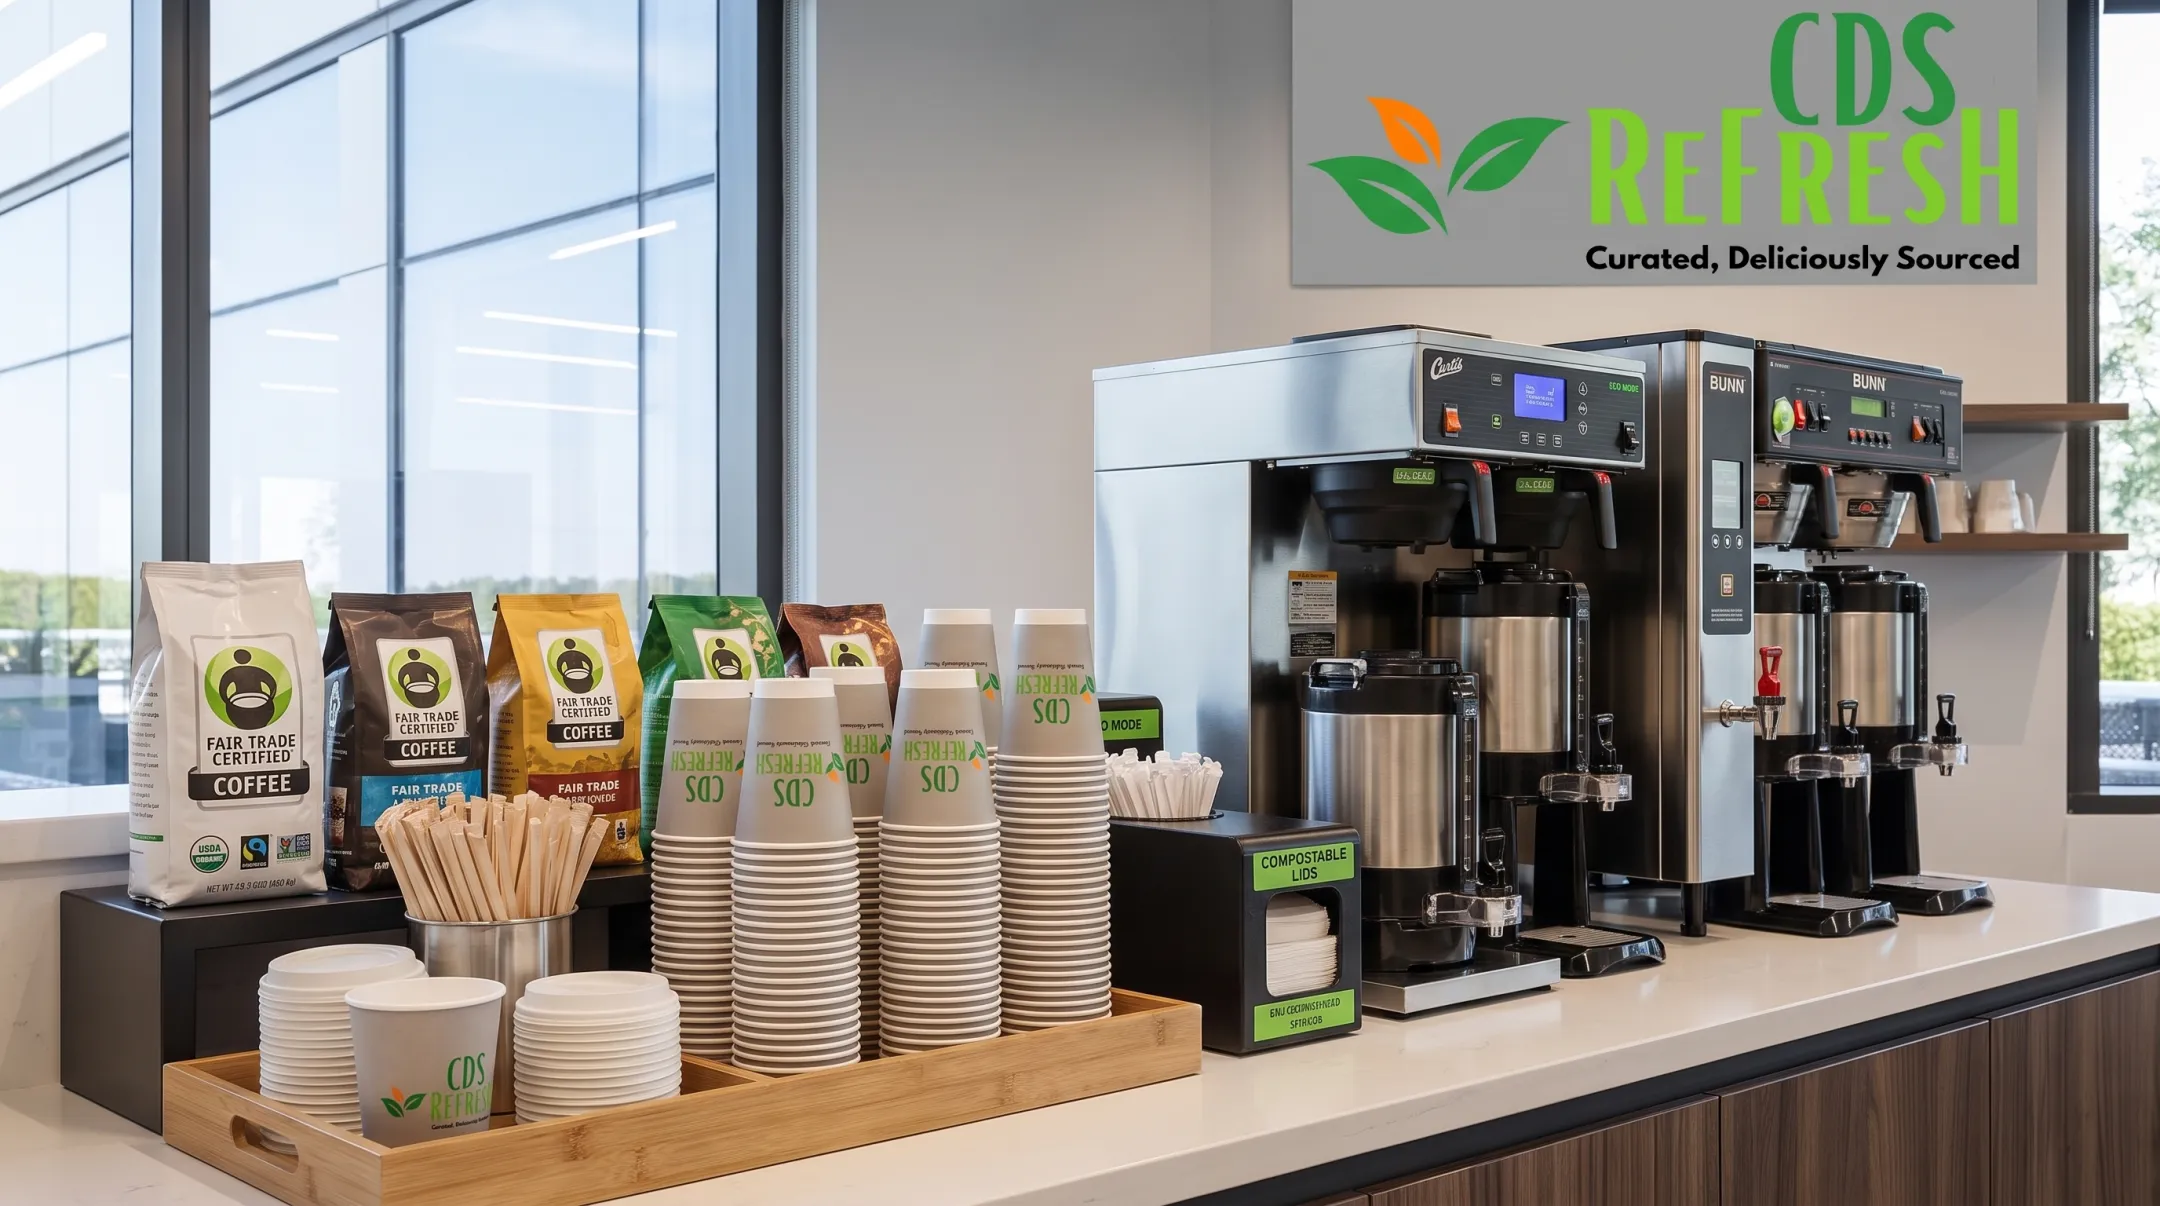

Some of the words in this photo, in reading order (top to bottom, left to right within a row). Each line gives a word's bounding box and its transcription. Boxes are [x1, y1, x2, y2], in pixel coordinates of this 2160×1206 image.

[1770, 12, 1956, 127] CDS
[1586, 245, 1719, 275] Curated,
[1729, 245, 1889, 277] Deliciously
[1897, 245, 2020, 271] Sourced
[1430, 356, 1463, 380] Curtis
[1710, 375, 1745, 393] BUNN
[1853, 373, 1886, 391] BUNN
[1016, 674, 1078, 696] REFRESH
[557, 697, 578, 707] FAIR
[580, 696, 613, 707] TRADE
[395, 713, 420, 723] FAIR
[423, 711, 459, 722] TRADE
[561, 707, 611, 718] CERTIFIED
[1032, 698, 1070, 725] CDS
[400, 723, 455, 735] CERTIFIED
[563, 725, 613, 740] COFFEE
[1111, 719, 1142, 731] MODE
[207, 736, 243, 751] FAIR
[248, 734, 296, 749] TRADE
[401, 741, 456, 757] COFFEE
[844, 734, 878, 755] REFR
[904, 740, 967, 762] REFRESH
[213, 750, 290, 766] CERTIFIED
[671, 750, 734, 773] REFRESH
[756, 753, 823, 775] REFRESH
[846, 757, 870, 785] CD
[920, 765, 960, 793] CDS
[213, 774, 292, 796] COFFEE
[392, 784, 420, 795] FAIR
[423, 782, 463, 794] TRADE
[558, 783, 583, 793] FAIR
[586, 780, 620, 792] TRADE
[685, 775, 724, 803] CDS
[773, 778, 815, 808] CDS
[198, 844, 221, 853] USDA
[1261, 847, 1347, 869] COMPOSTABLE
[1292, 867, 1318, 881] LIDS
[206, 885, 220, 893] NET
[222, 883, 234, 892] WT
[447, 1052, 485, 1091] CDS
